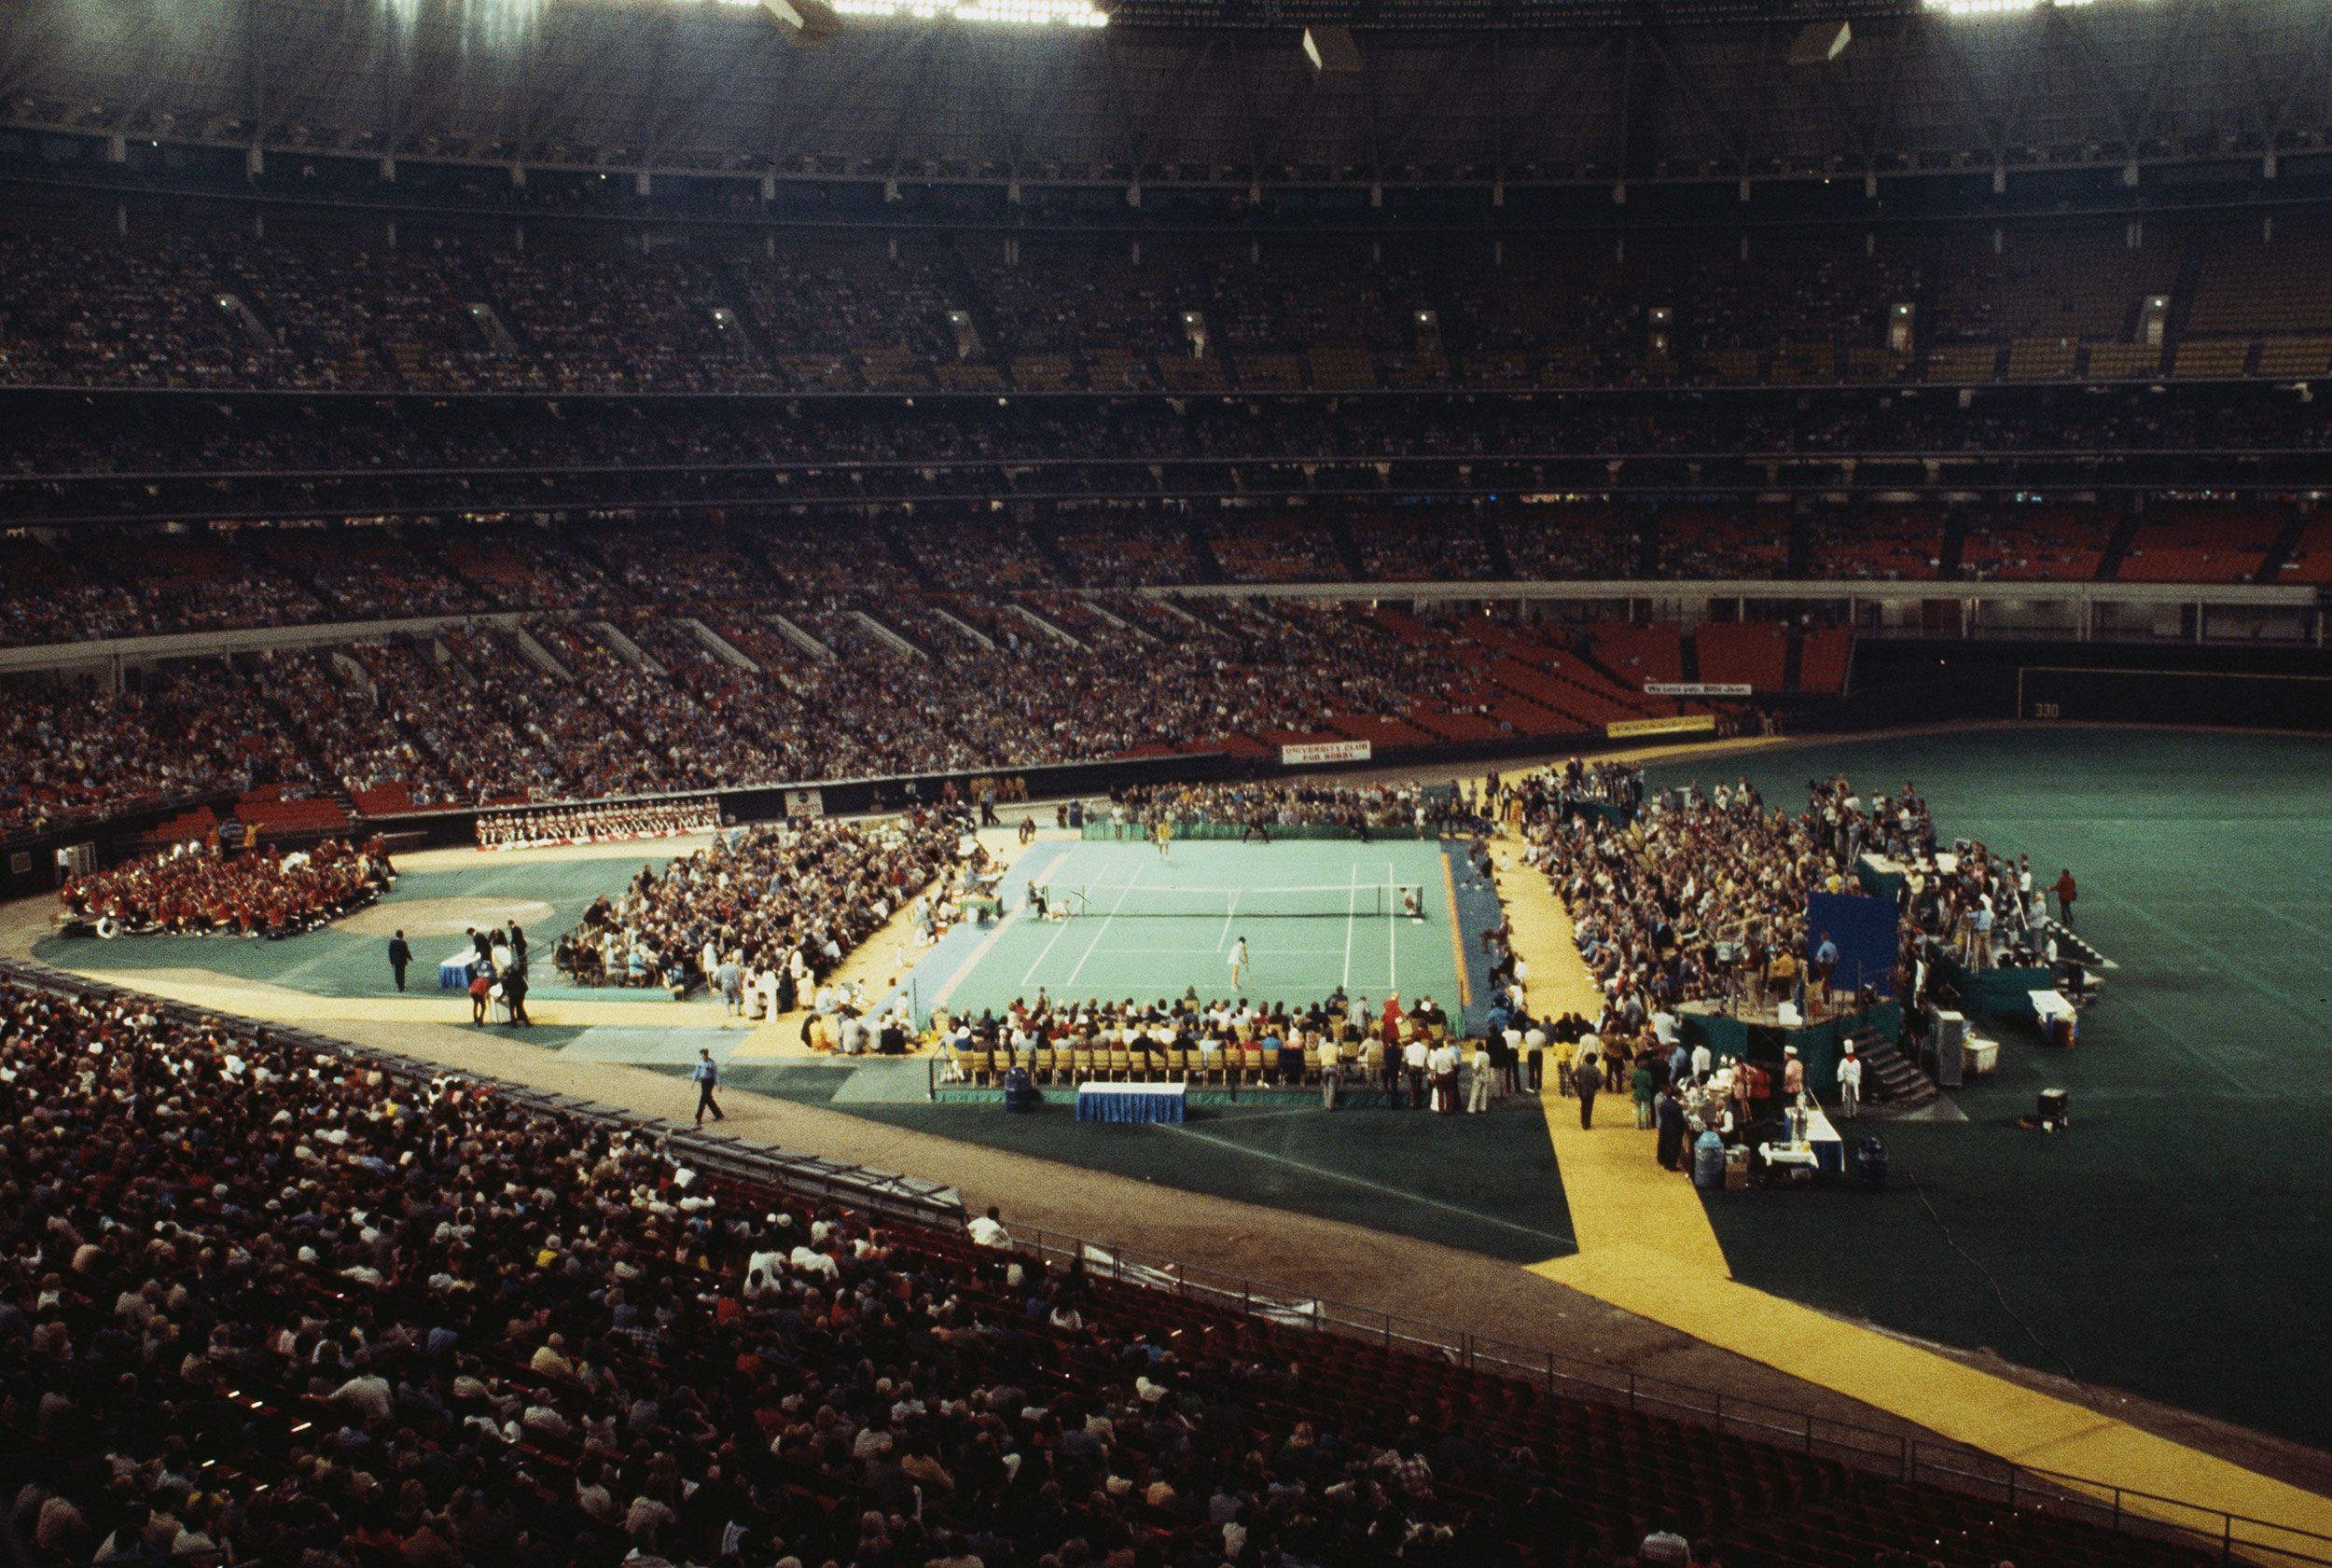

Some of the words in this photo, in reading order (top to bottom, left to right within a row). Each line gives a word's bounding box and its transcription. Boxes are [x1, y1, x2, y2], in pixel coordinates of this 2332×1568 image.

[2035, 702, 2059, 716] 330
[1285, 744, 1340, 754] UNIVERSITY
[1344, 742, 1367, 752] CLUB
[1302, 753, 1321, 761] FOR
[1324, 751, 1353, 760] BOBBY
